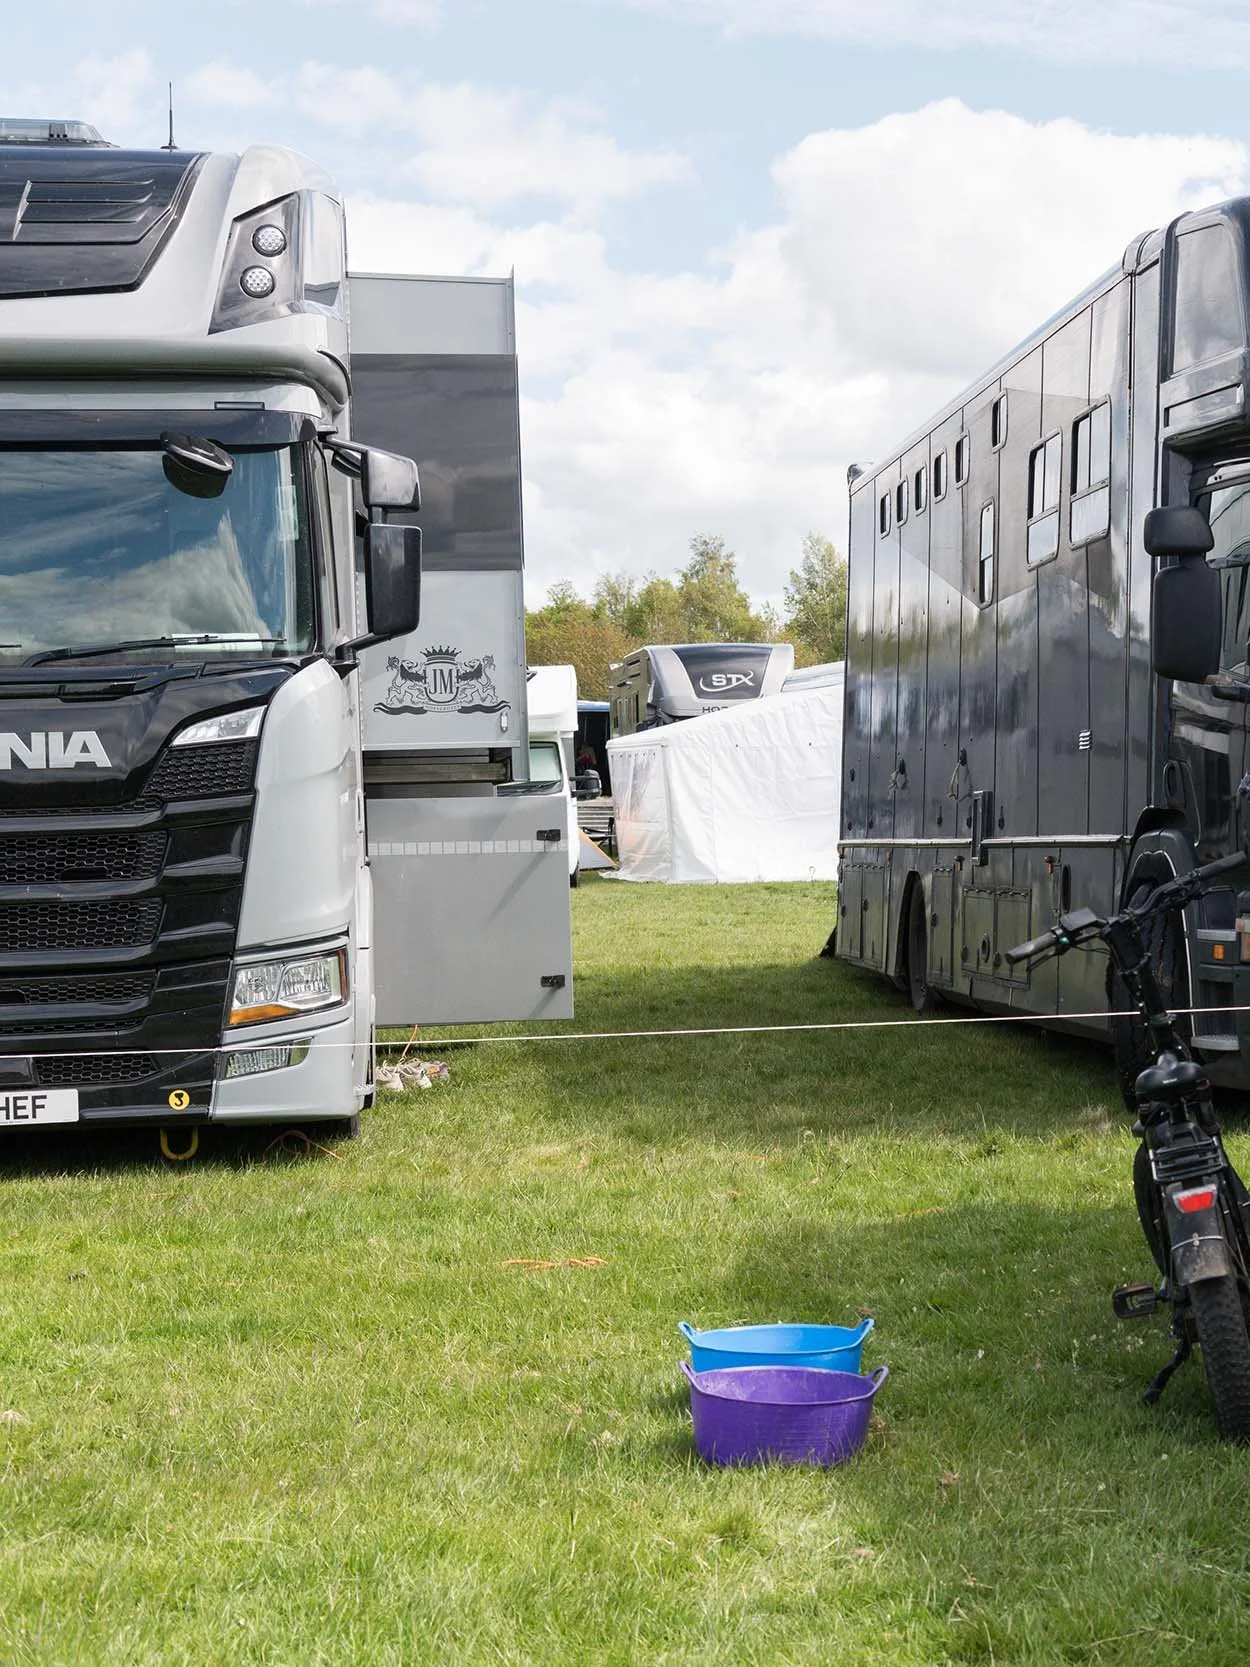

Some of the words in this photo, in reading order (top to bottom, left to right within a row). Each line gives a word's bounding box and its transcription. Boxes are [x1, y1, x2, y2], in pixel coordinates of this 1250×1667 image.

[428, 668, 454, 695] JM
[708, 670, 754, 688] STX
[0, 730, 112, 770] NIA
